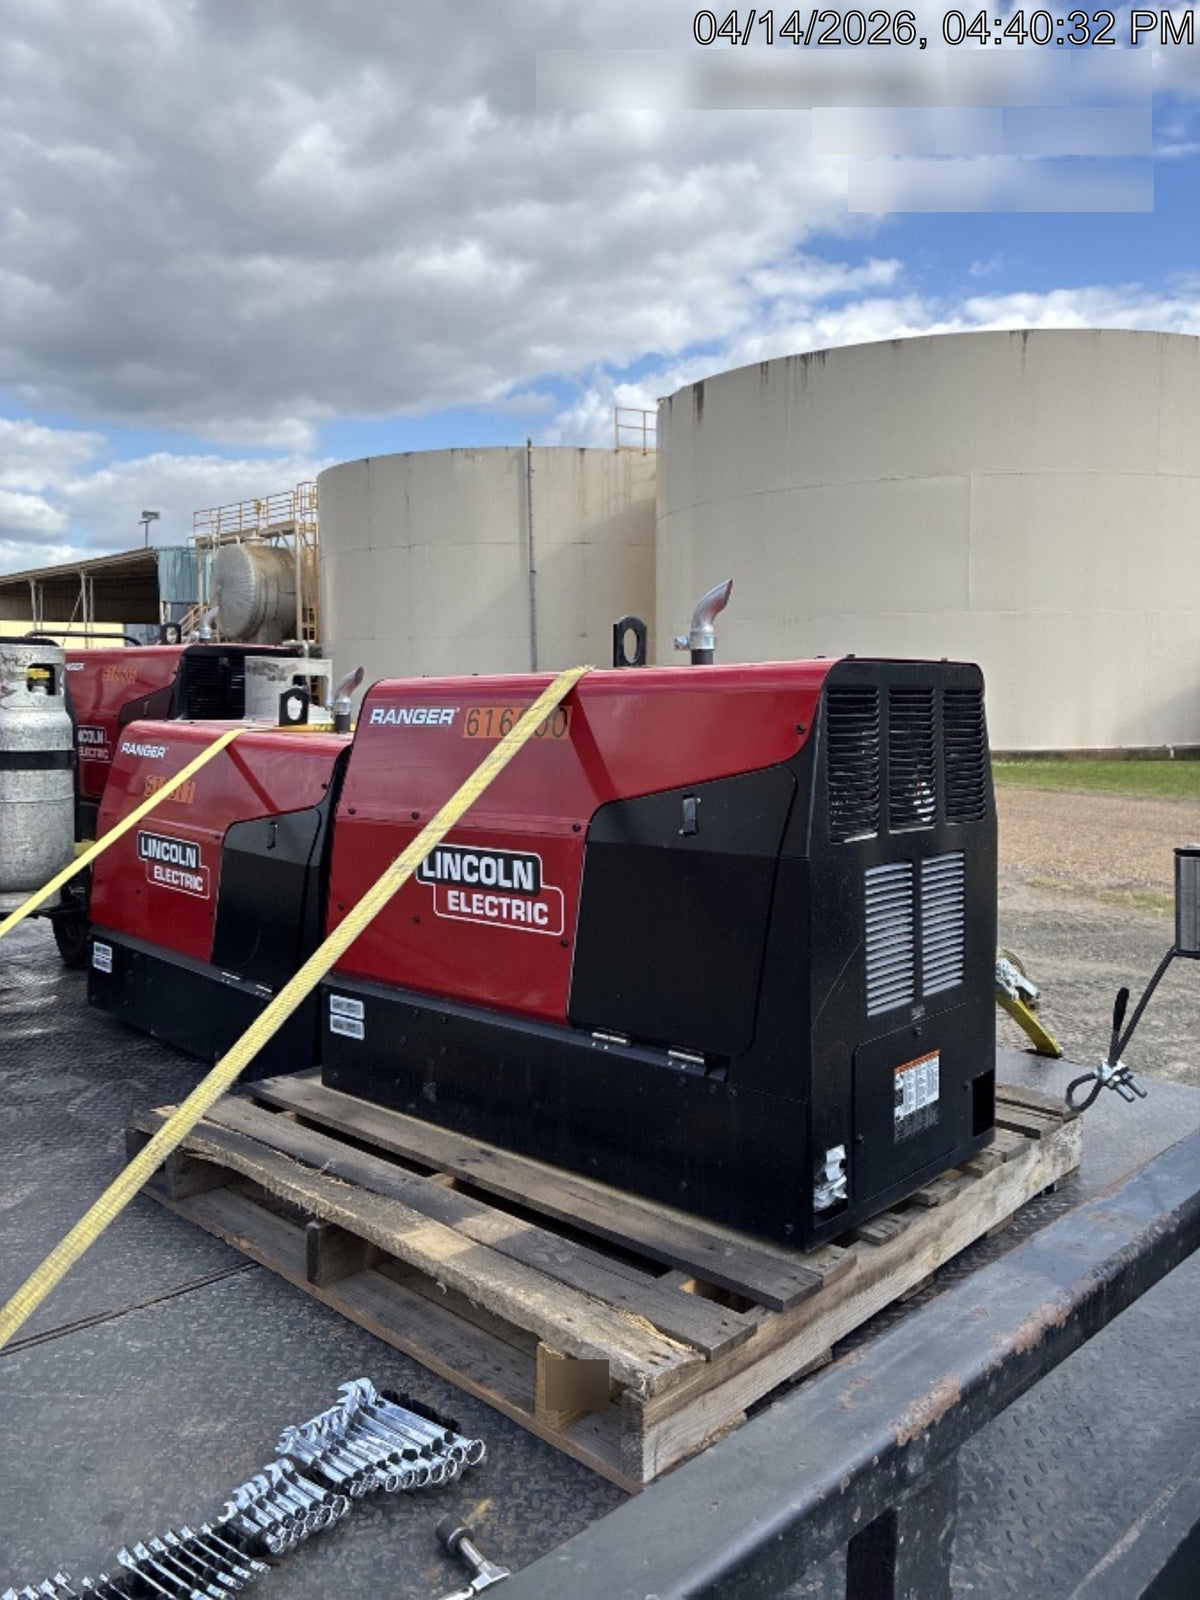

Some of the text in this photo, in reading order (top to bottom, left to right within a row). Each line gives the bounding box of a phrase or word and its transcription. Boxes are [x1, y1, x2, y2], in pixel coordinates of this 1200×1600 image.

[369, 707, 455, 725] RANGER
[122, 742, 166, 758] RANGER
[141, 836, 197, 868] LINCOLN
[154, 865, 203, 892] ELECTRIC
[421, 851, 534, 891] LINCOLN
[447, 890, 549, 926] ELECTRIC
